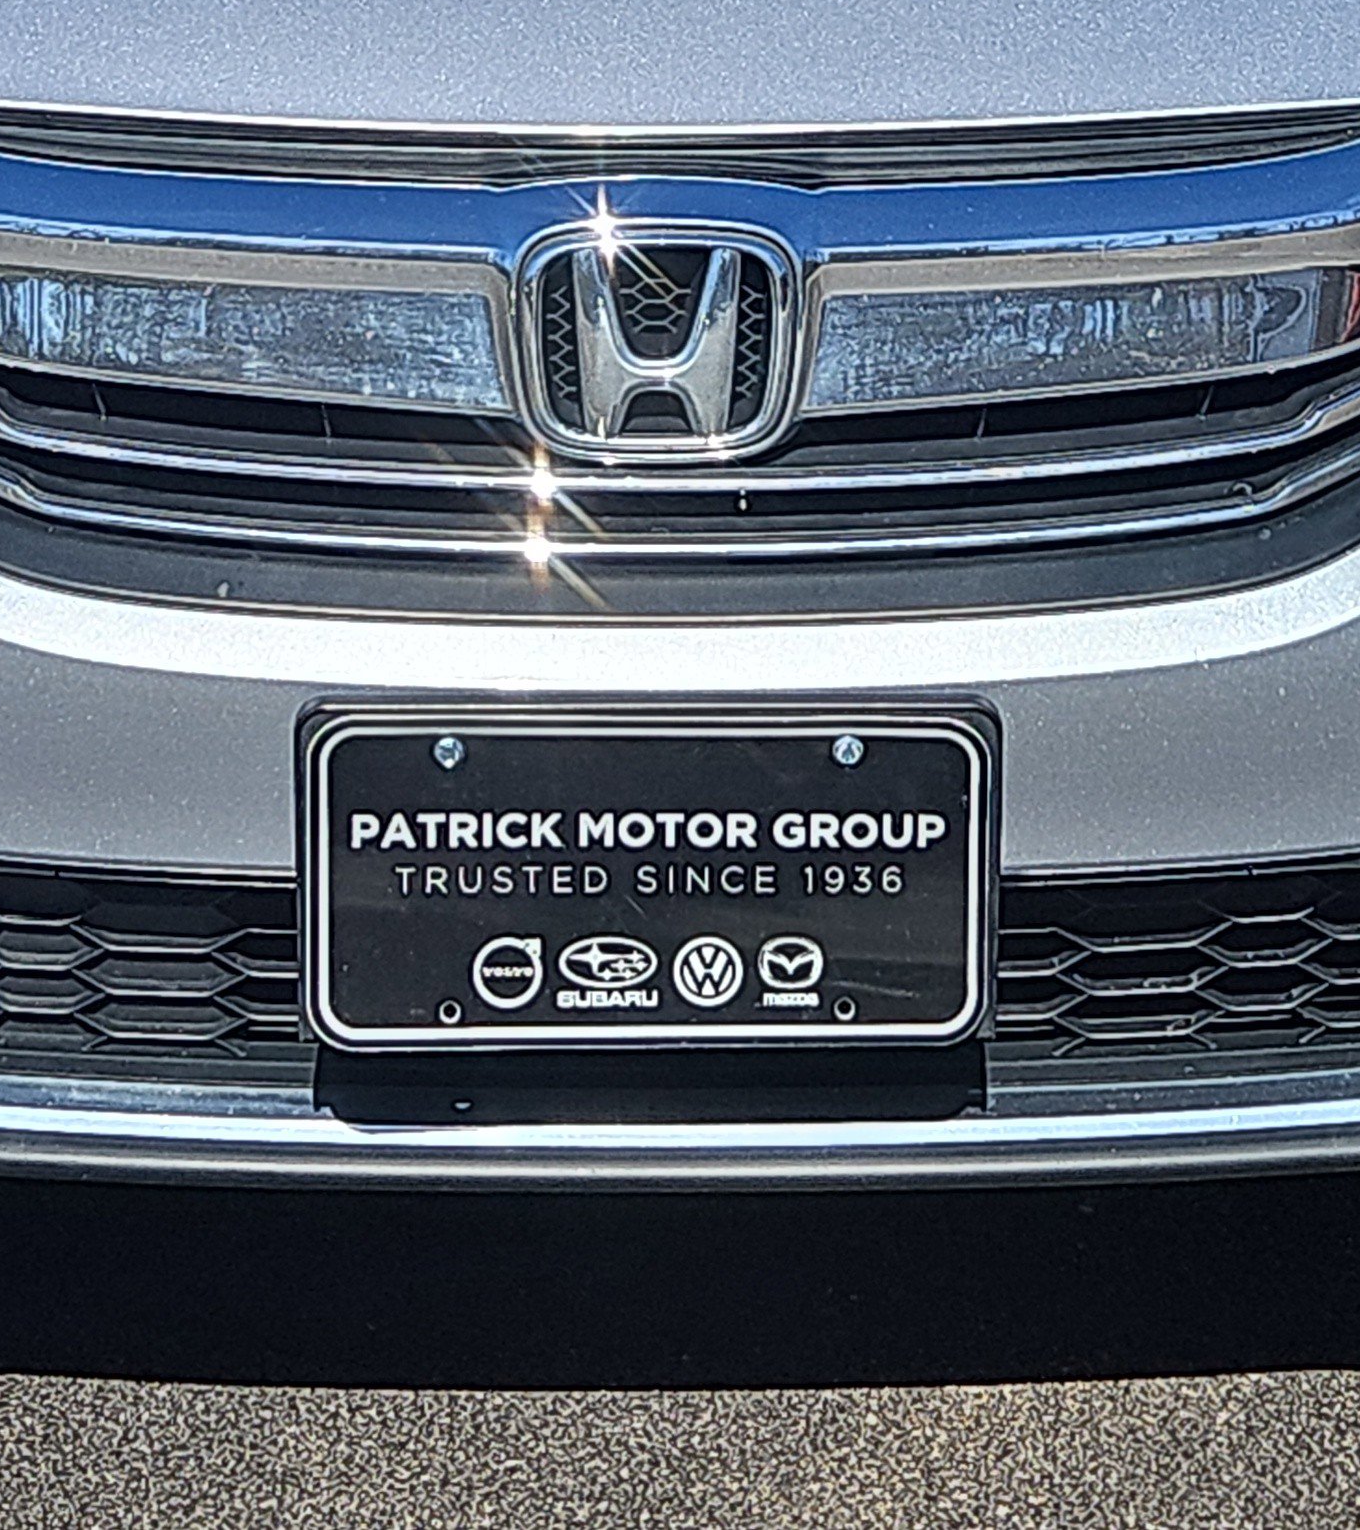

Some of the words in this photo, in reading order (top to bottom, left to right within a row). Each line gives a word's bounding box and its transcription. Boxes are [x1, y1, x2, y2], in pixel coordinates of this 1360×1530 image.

[350, 812, 564, 849] PATRICK
[577, 812, 757, 849] MOTOR
[771, 812, 946, 849] GROUP
[394, 867, 608, 894] TRUSTED
[636, 867, 775, 894] SINCE
[802, 867, 904, 894] 1936
[481, 965, 535, 978] VOLVO
[556, 989, 659, 1008] SUBARU
